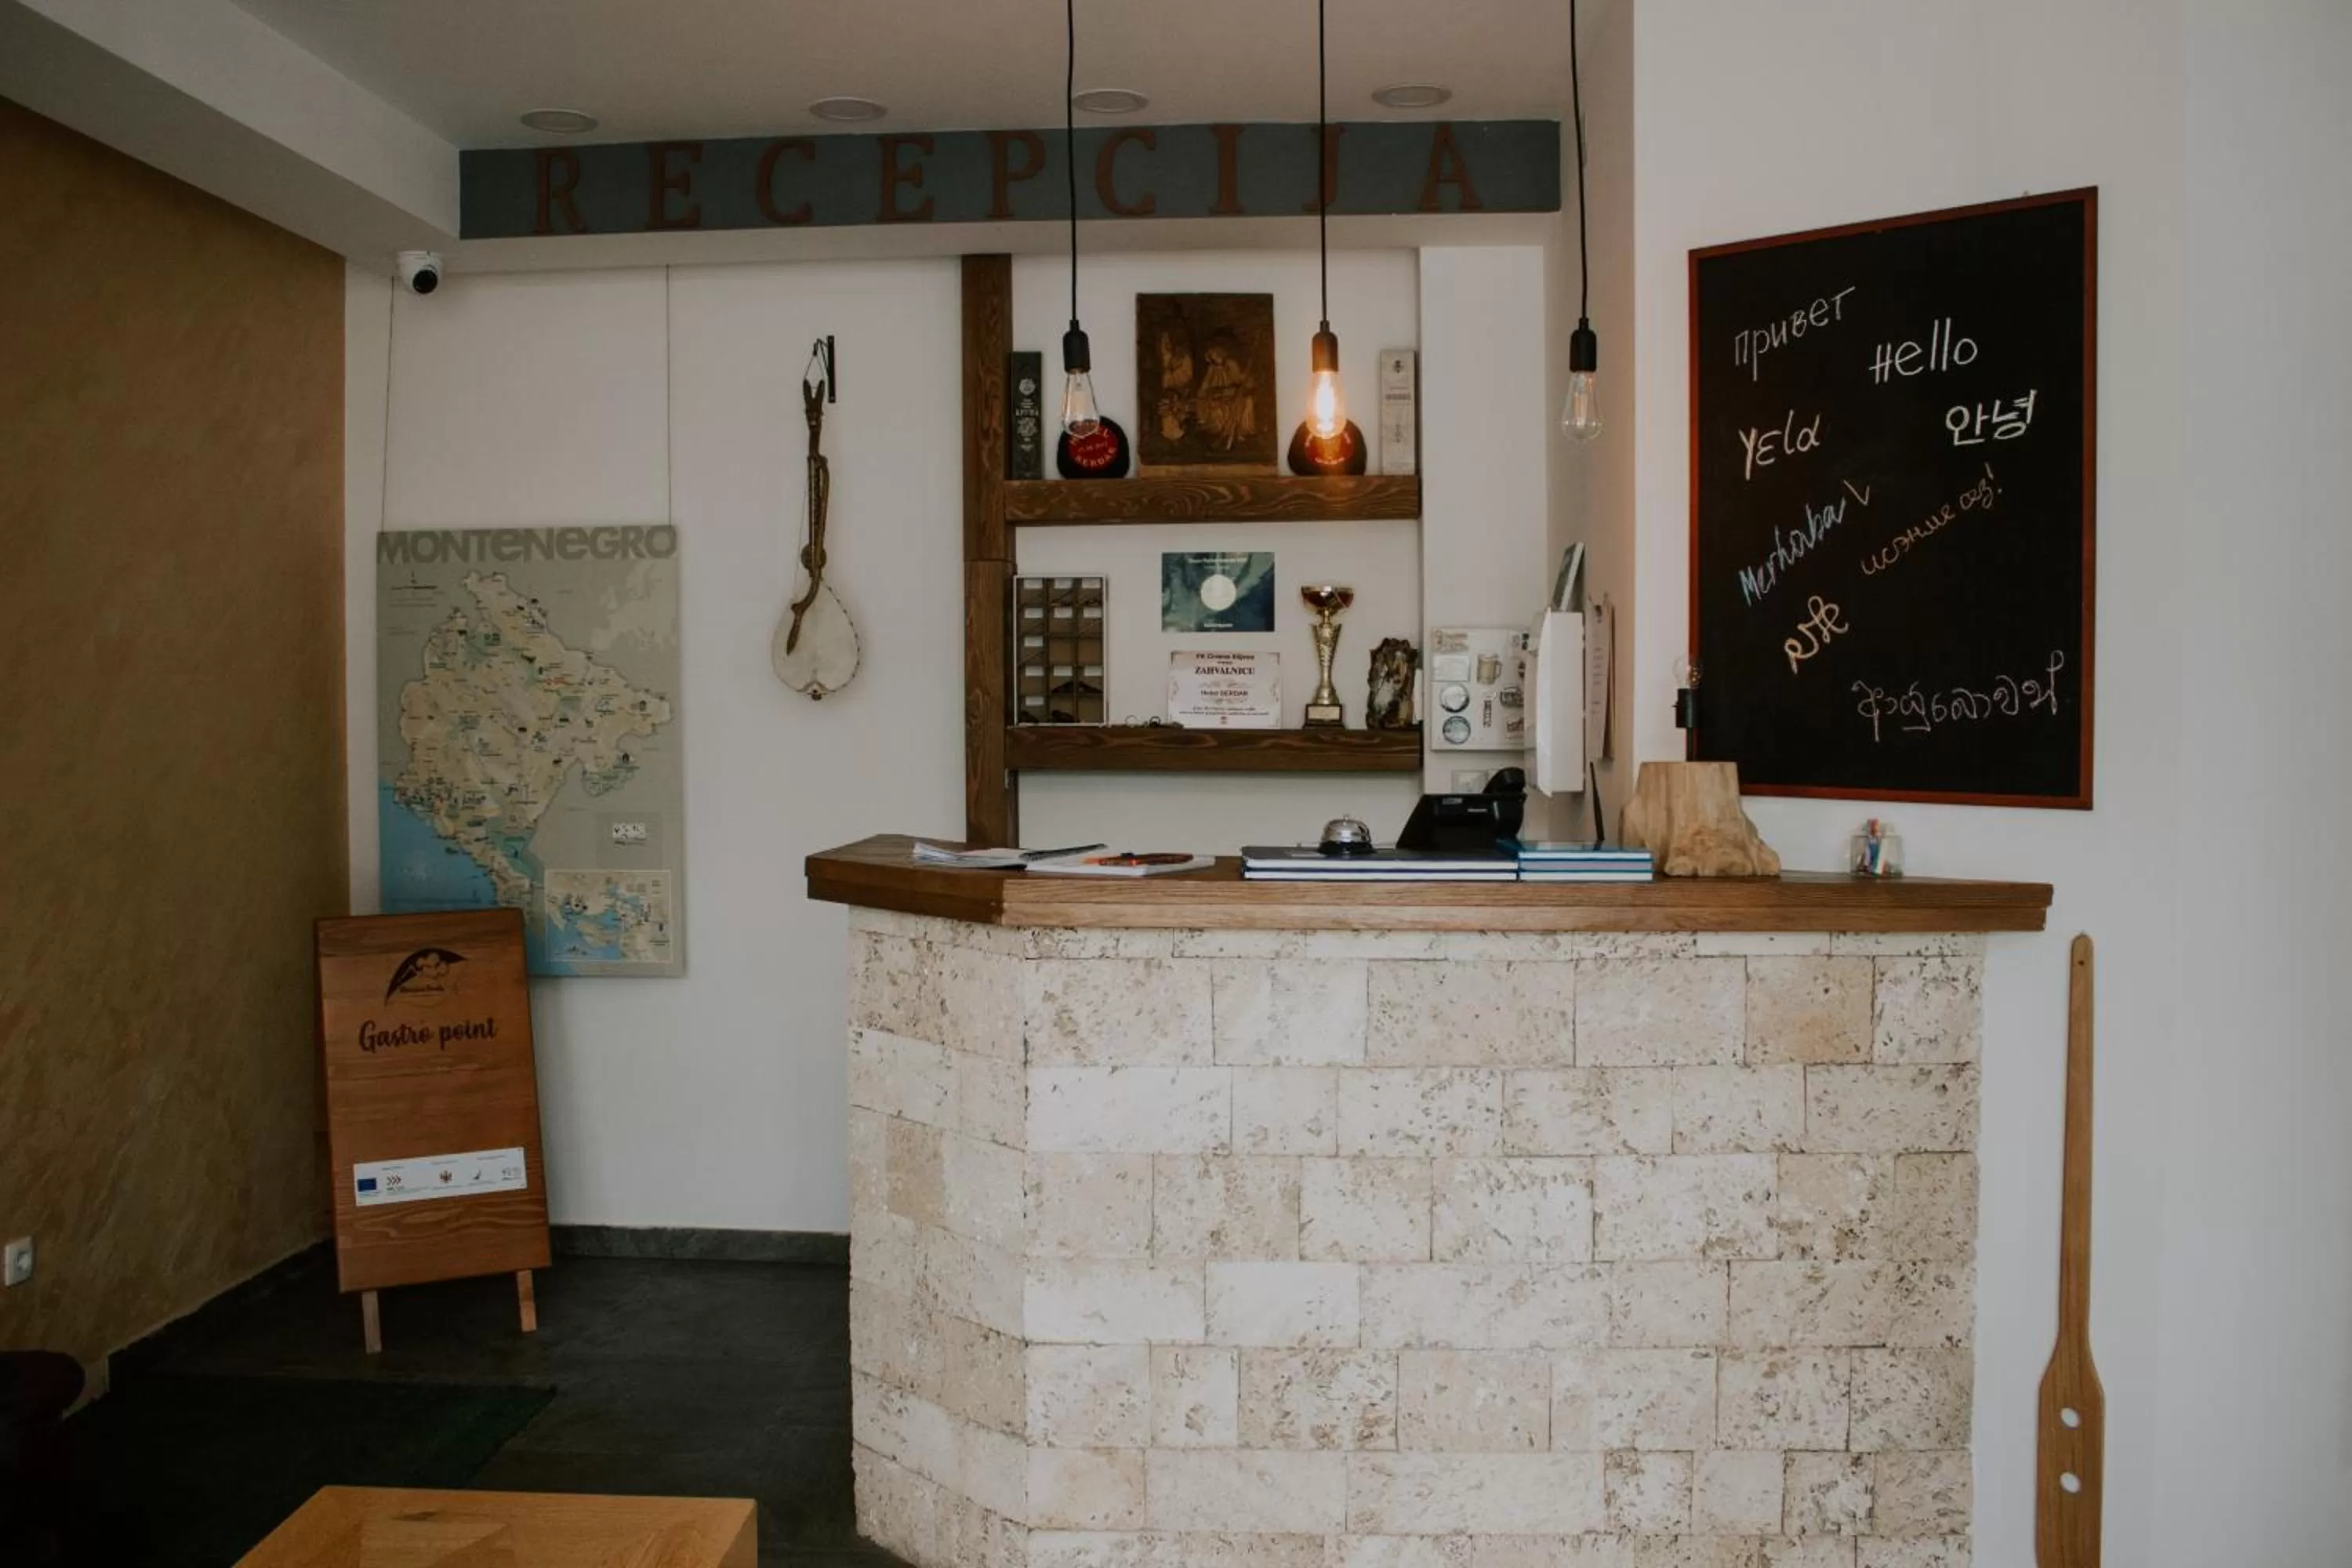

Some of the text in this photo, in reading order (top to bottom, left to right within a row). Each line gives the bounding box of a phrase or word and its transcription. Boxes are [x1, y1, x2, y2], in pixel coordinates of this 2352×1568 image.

[532, 121, 1484, 234] RECEPCIJA
[1868, 316, 1979, 384] Hello
[1945, 388, 2038, 446] 안녕
[1194, 666, 1255, 675] ZAHVALNICU
[358, 1015, 499, 1054] Gastro point
